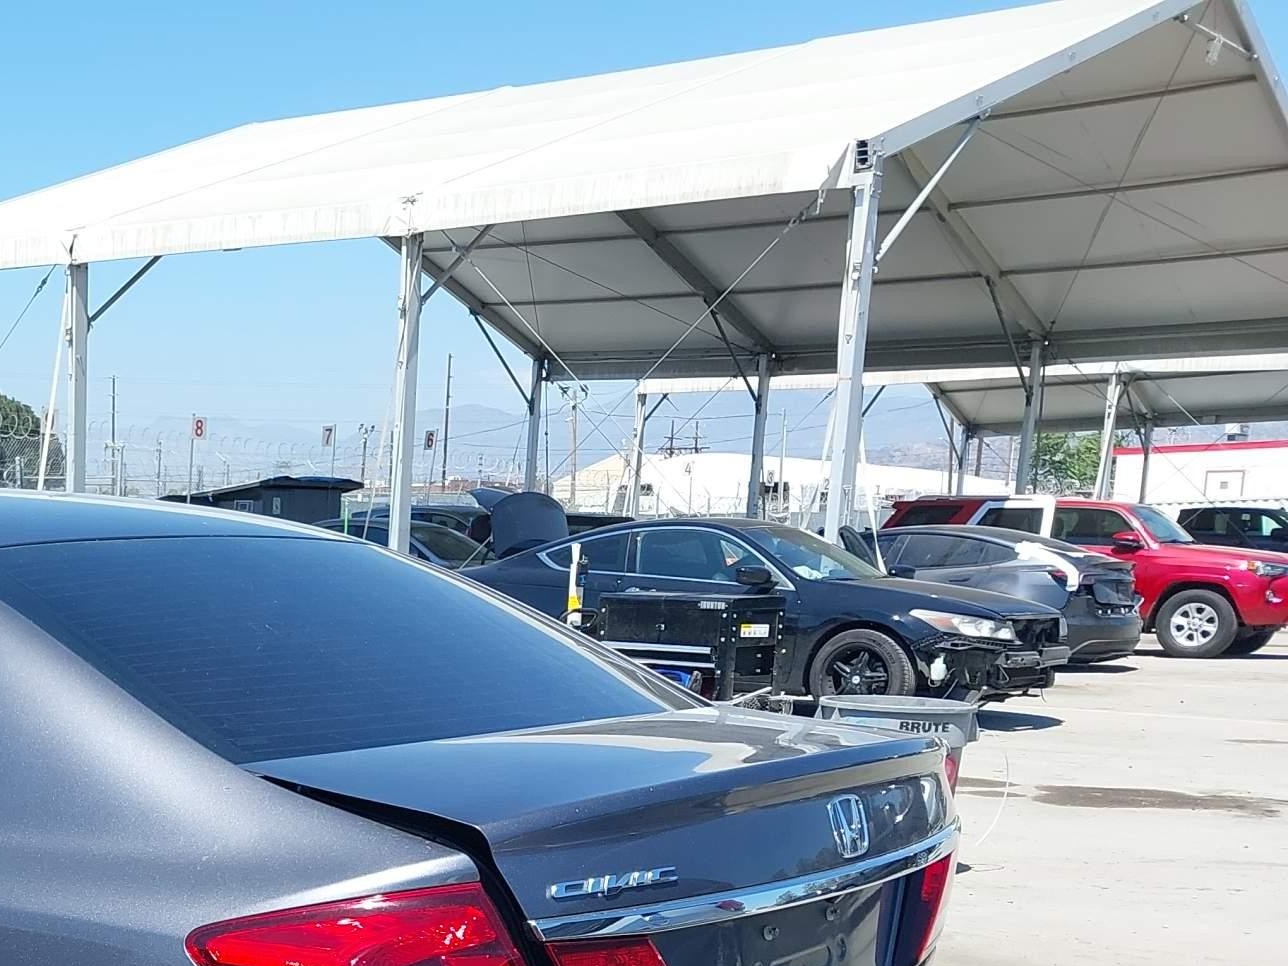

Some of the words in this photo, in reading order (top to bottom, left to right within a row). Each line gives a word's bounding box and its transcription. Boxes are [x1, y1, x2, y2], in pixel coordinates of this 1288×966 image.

[195, 419, 203, 437] 8
[325, 428, 333, 445] 7
[427, 432, 435, 448] 6
[684, 462, 692, 476] 4
[548, 866, 680, 898] CIVIC
